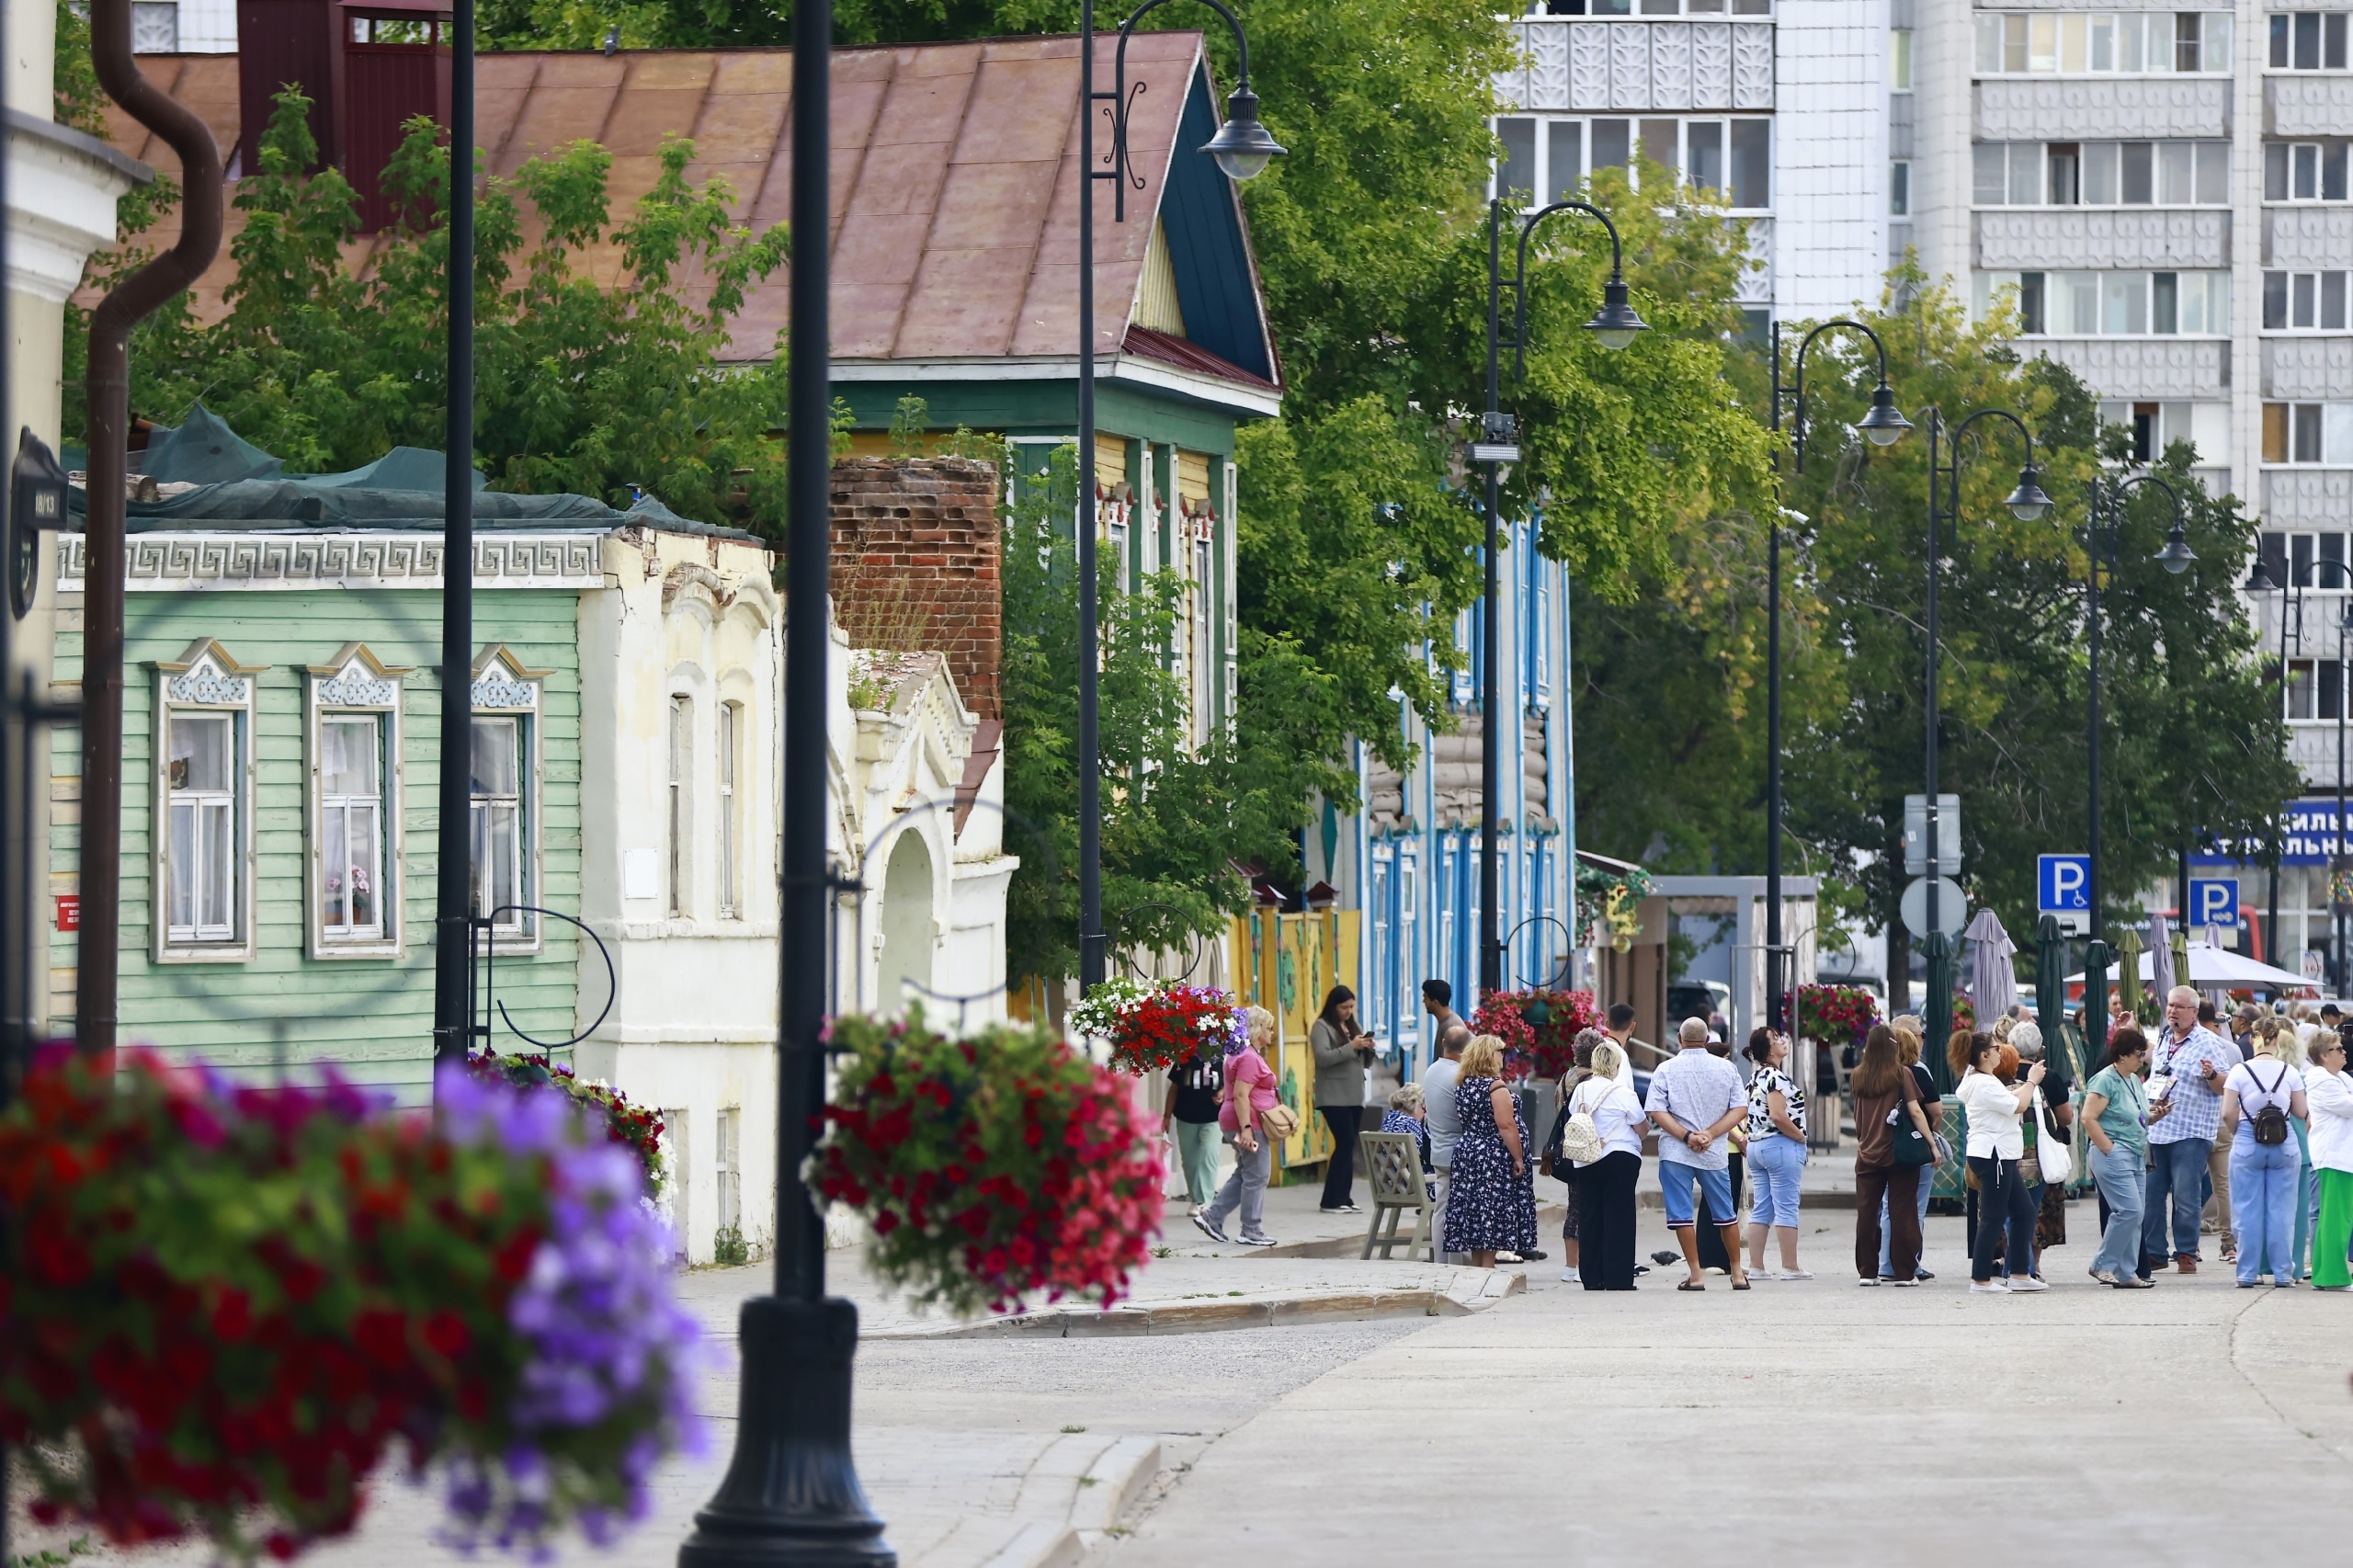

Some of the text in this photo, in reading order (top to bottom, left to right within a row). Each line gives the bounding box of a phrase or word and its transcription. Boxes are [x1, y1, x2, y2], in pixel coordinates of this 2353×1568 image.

[35, 494, 55, 514] 18/13
[2054, 861, 2085, 905] P
[2203, 883, 2230, 923] P
